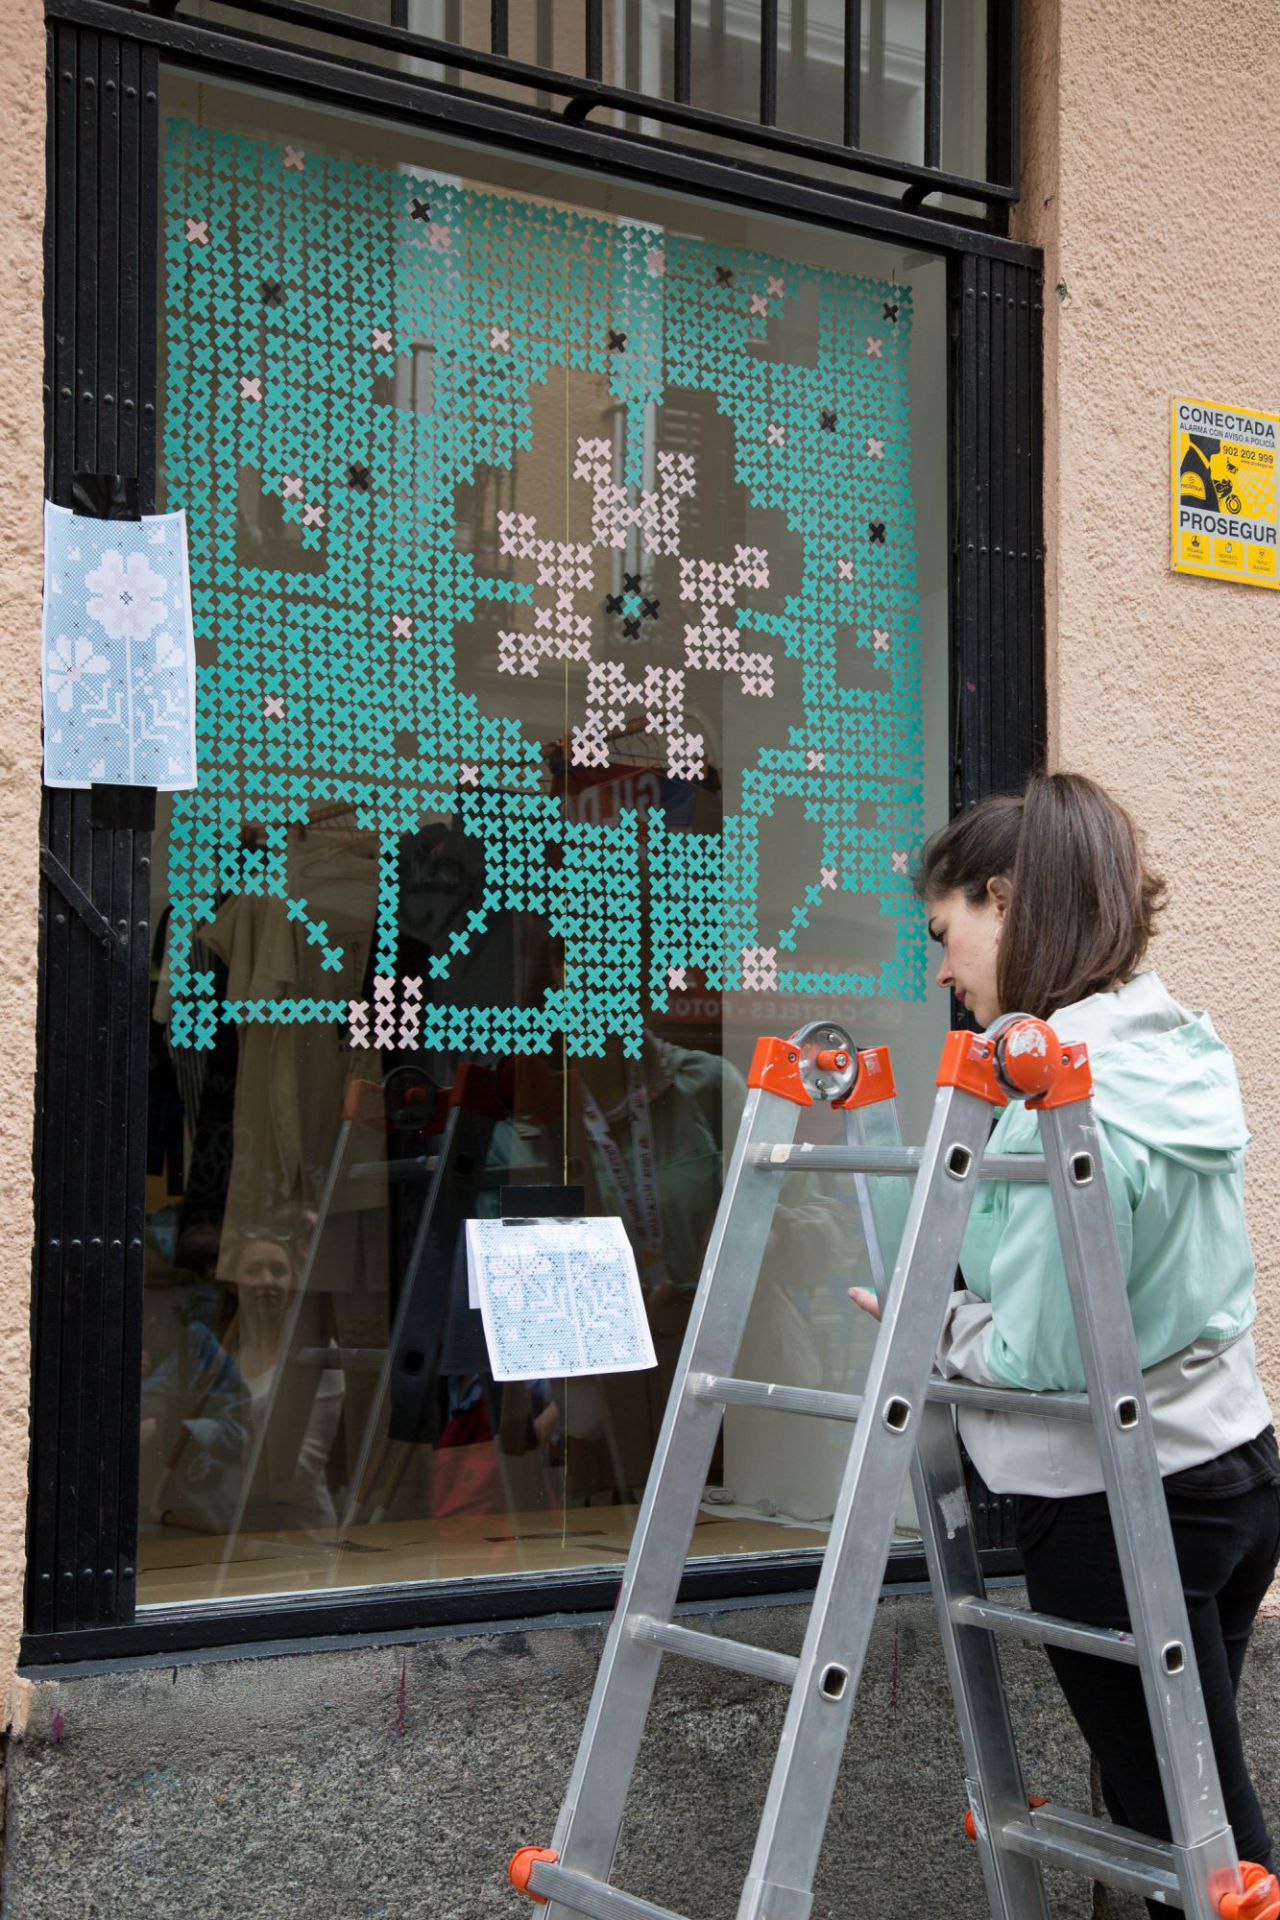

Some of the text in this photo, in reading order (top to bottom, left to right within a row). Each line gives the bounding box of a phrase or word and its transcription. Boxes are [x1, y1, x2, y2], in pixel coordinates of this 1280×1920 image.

[1179, 405, 1276, 439] CONECTADA
[1180, 422, 1208, 435] ALARMA
[1209, 427, 1224, 438] CON
[1224, 431, 1244, 442] AVISO
[1223, 445, 1274, 464] 902 202 999
[1180, 511, 1277, 545] PROSEGUR
